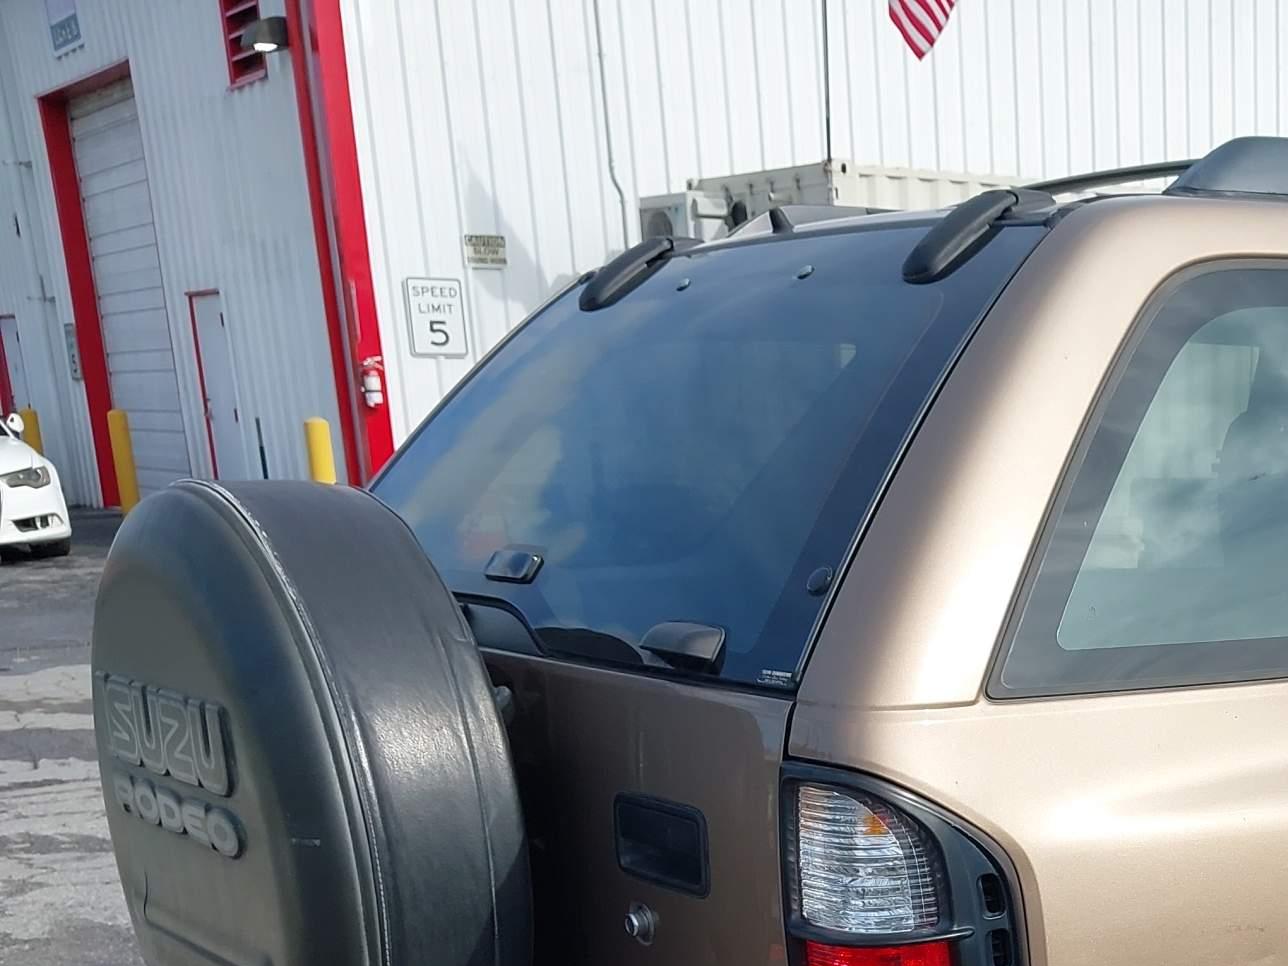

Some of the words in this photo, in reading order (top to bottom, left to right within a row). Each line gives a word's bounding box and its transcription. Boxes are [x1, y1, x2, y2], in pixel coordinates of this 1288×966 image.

[412, 286, 457, 298] SPEED
[418, 303, 455, 315] LIMIT
[429, 320, 449, 346] 5
[112, 773, 247, 860] RODEO
